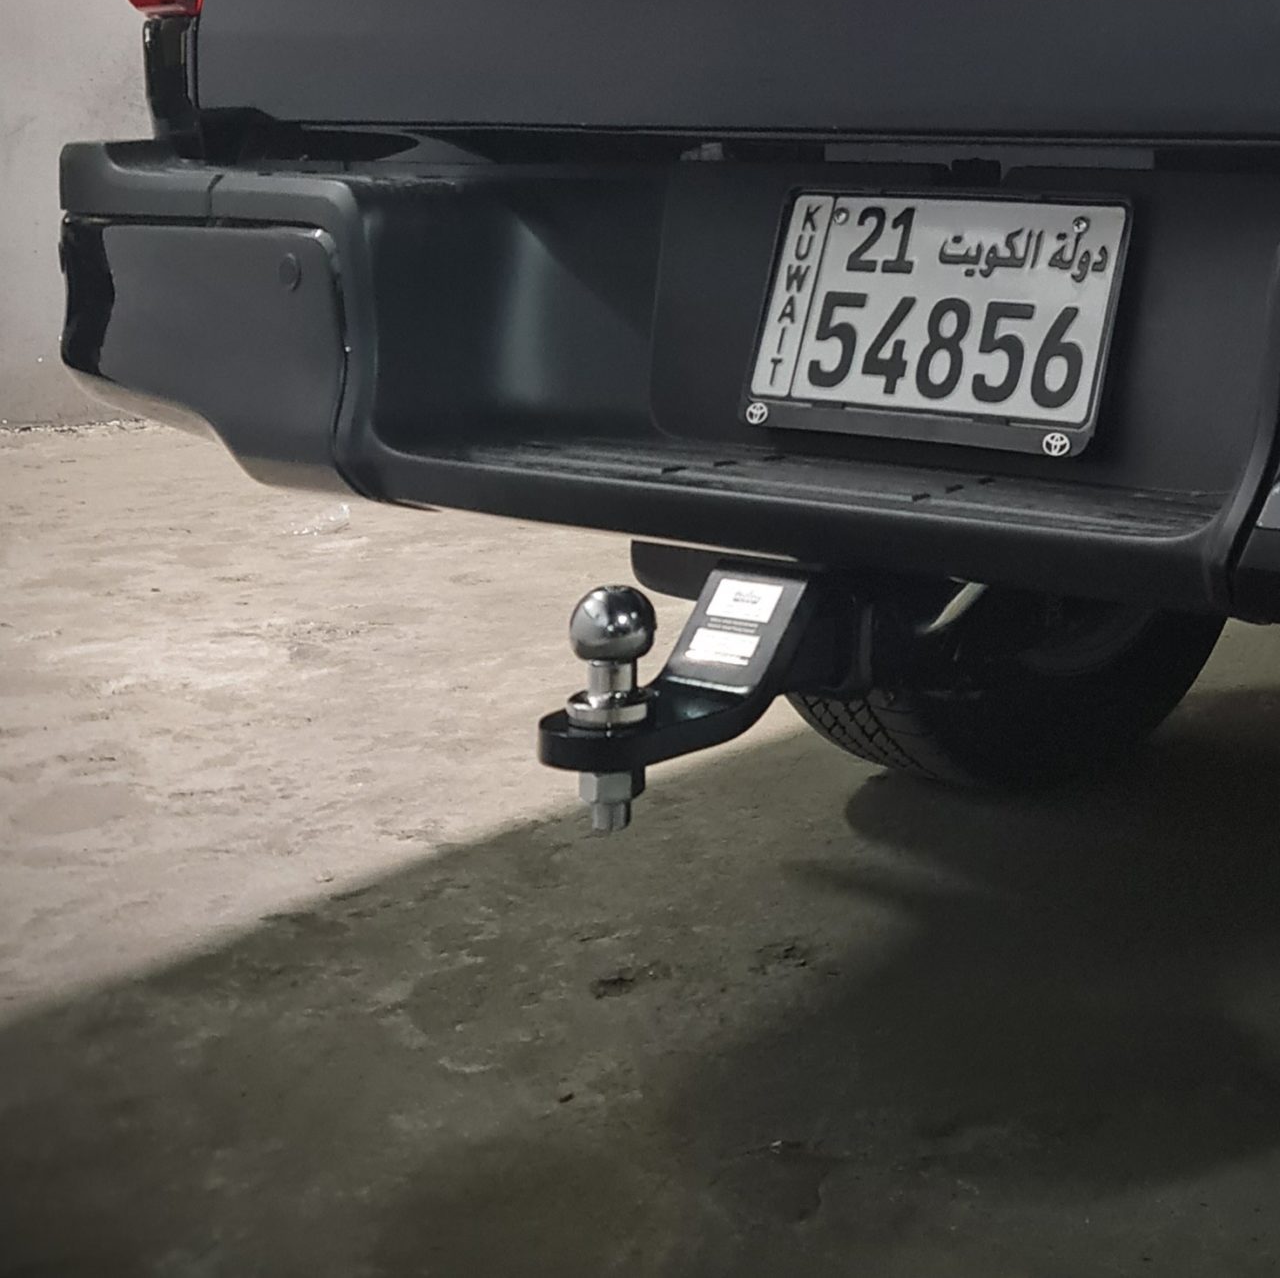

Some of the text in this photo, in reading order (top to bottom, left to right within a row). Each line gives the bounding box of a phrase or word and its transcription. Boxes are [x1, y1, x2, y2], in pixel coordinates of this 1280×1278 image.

[846, 206, 916, 275] 21
[938, 224, 1109, 283] دولة الكويت
[770, 206, 822, 387] KUWAIT
[807, 291, 1084, 409] 54856
